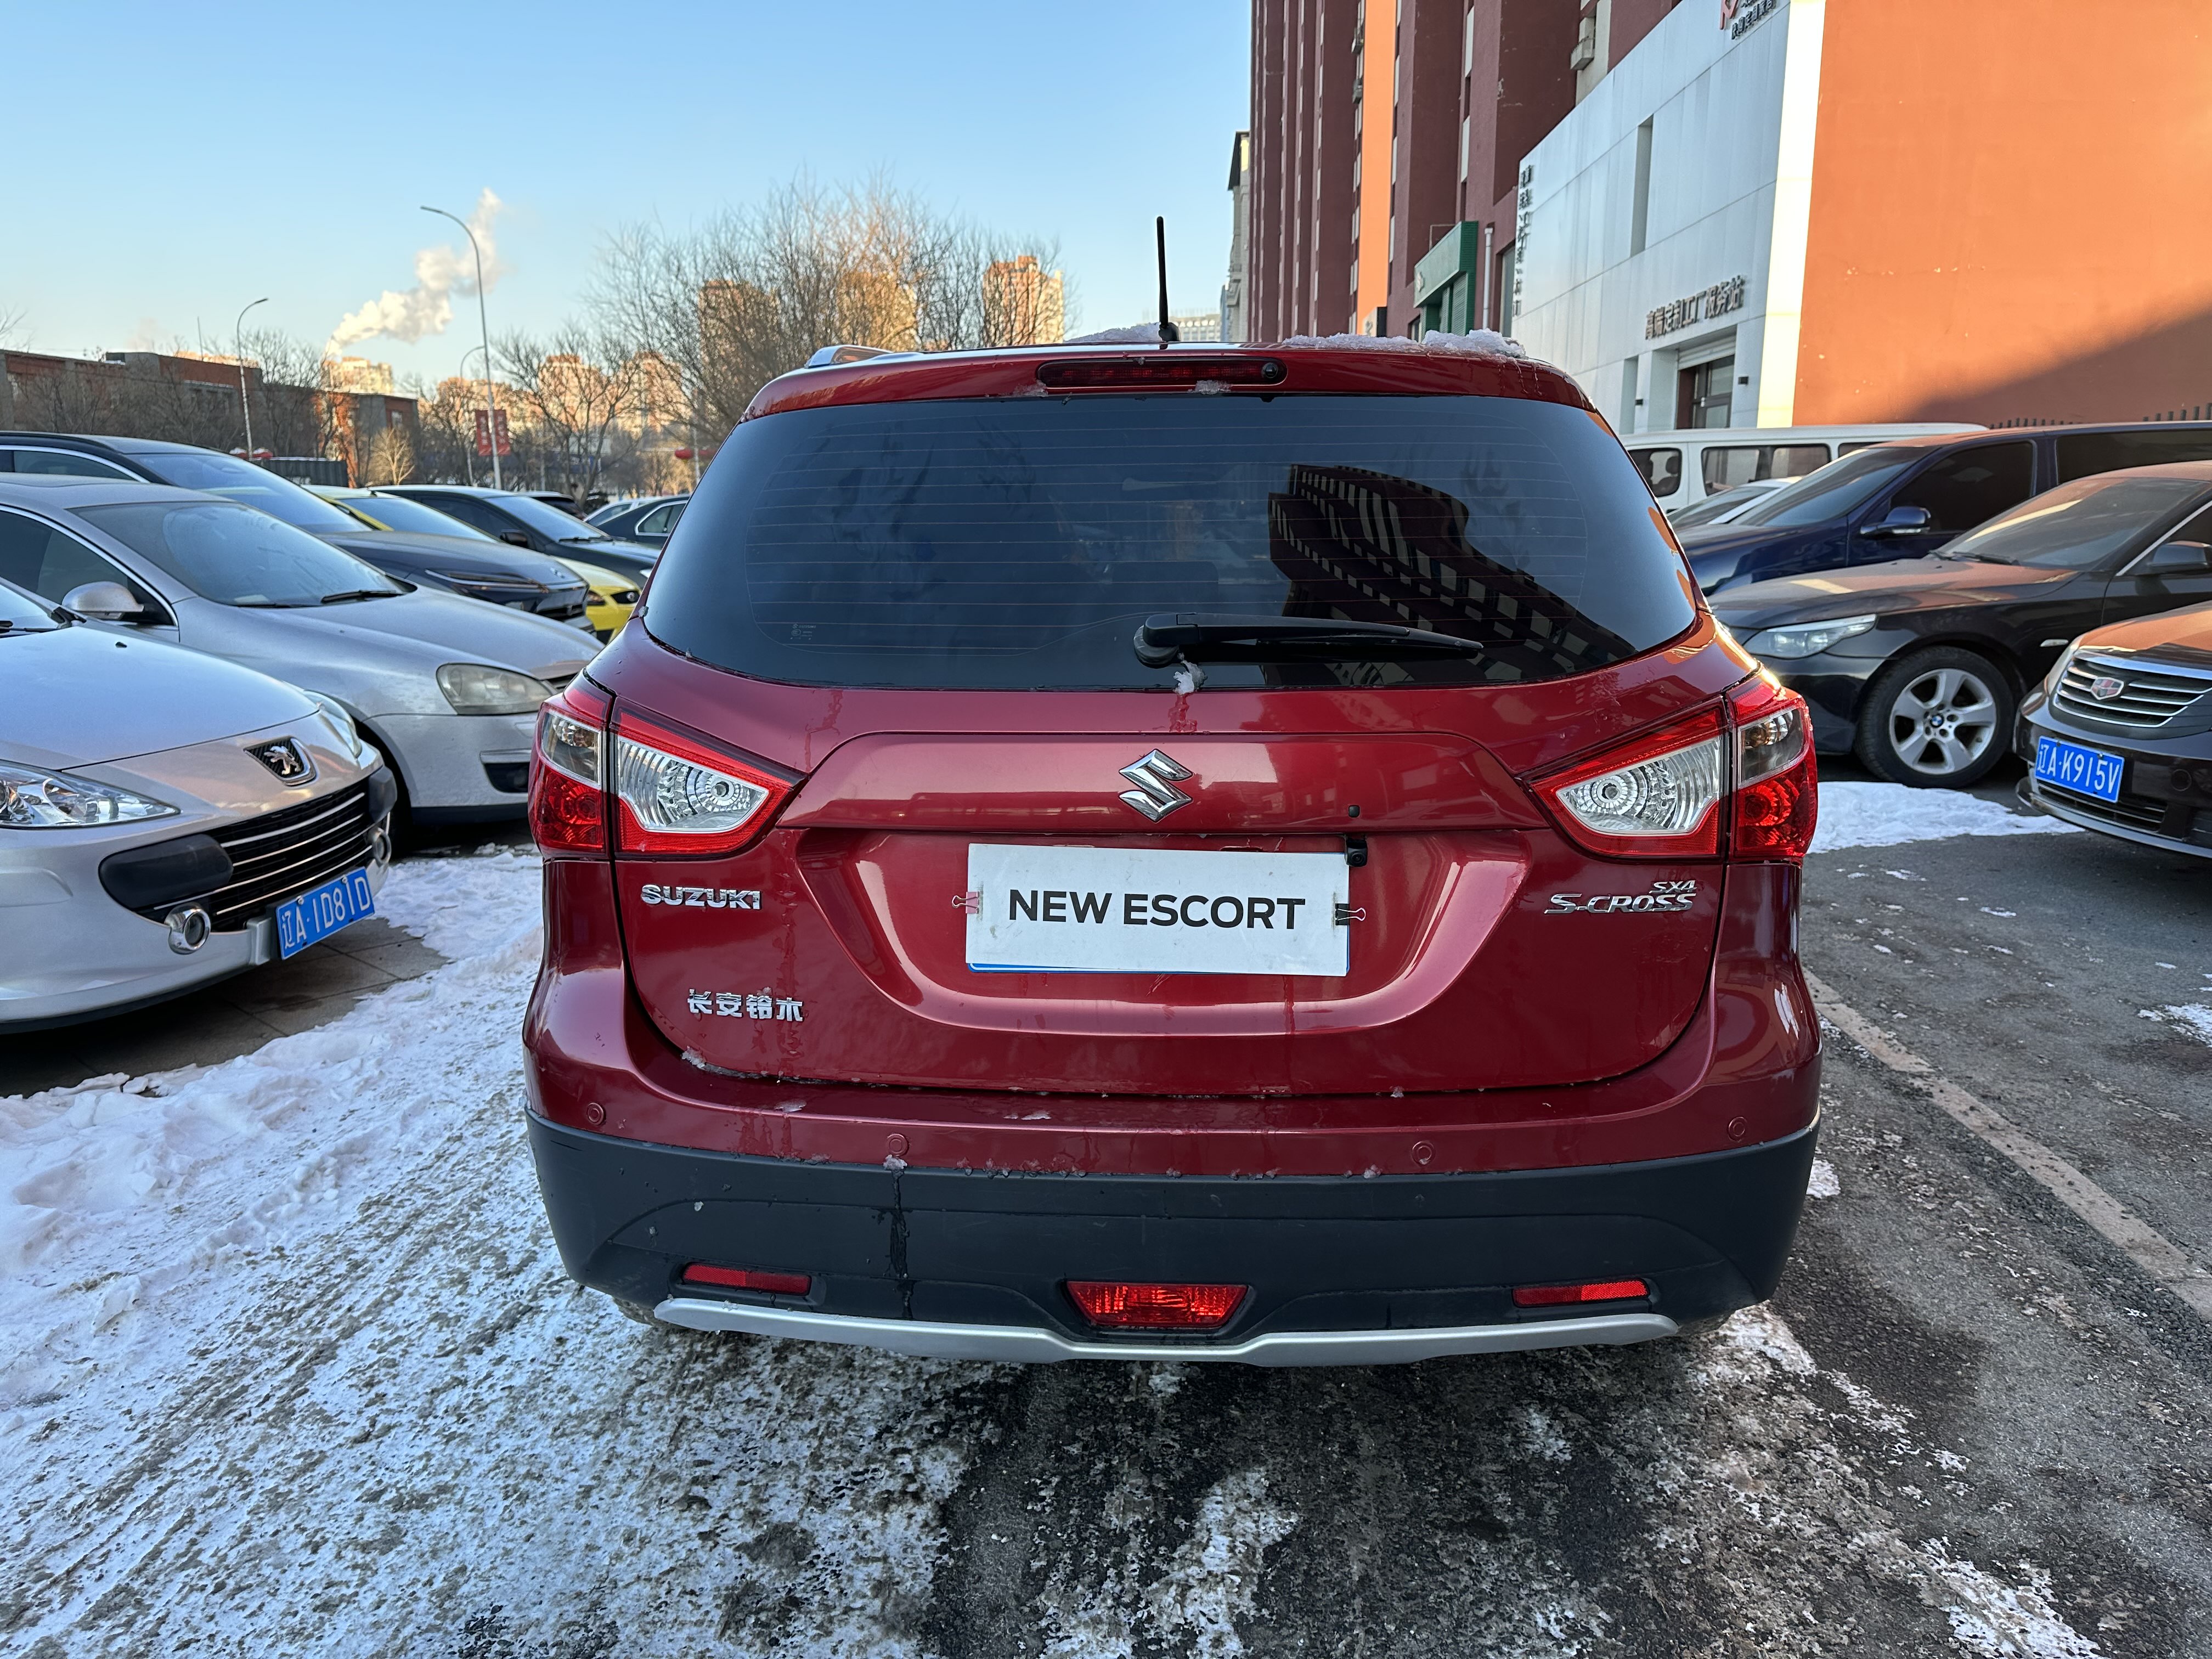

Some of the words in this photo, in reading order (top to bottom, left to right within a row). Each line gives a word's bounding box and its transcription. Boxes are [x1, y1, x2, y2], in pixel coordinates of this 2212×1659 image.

[1645, 275, 1745, 340] 高端定制工厂服务站
[2037, 744, 2120, 793] 辽A·K915V
[641, 884, 763, 910] SUZUKI
[1544, 893, 1697, 915] S-CROSS
[1649, 880, 1697, 894] SX4
[1009, 889, 1111, 924] NEW
[1124, 894, 1306, 930] ESCORT
[687, 988, 804, 1022] 长安铃木
